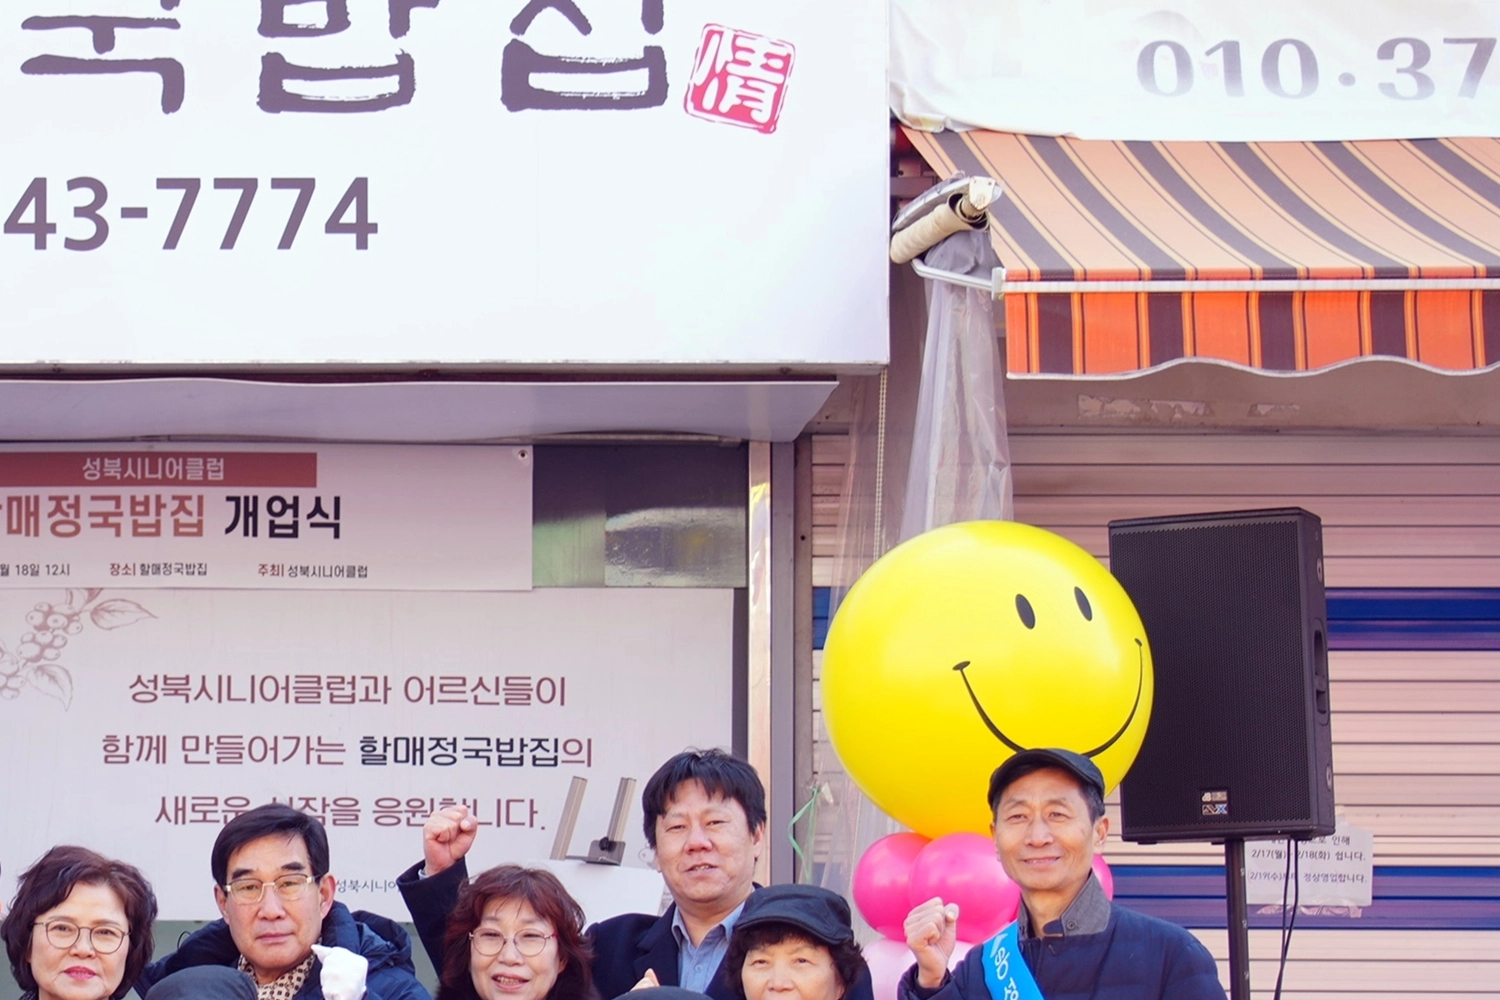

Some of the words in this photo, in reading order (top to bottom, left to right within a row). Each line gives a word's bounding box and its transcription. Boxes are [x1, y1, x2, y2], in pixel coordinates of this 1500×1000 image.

[82, 457, 224, 481] 성북시니어클럽
[224, 495, 341, 539] 개업식
[15, 563, 40, 577] 18일
[46, 563, 70, 577] 12시
[140, 562, 208, 577] 할매정국밥집
[287, 564, 368, 578] 성북시니어클럽
[128, 674, 392, 704] 성북시니어클럽과
[403, 676, 566, 706] 어르신들이
[102, 735, 167, 764] 함께
[181, 735, 346, 765] 만들어가는
[359, 736, 593, 767] 할매정국밥집의
[271, 796, 362, 827] 작을
